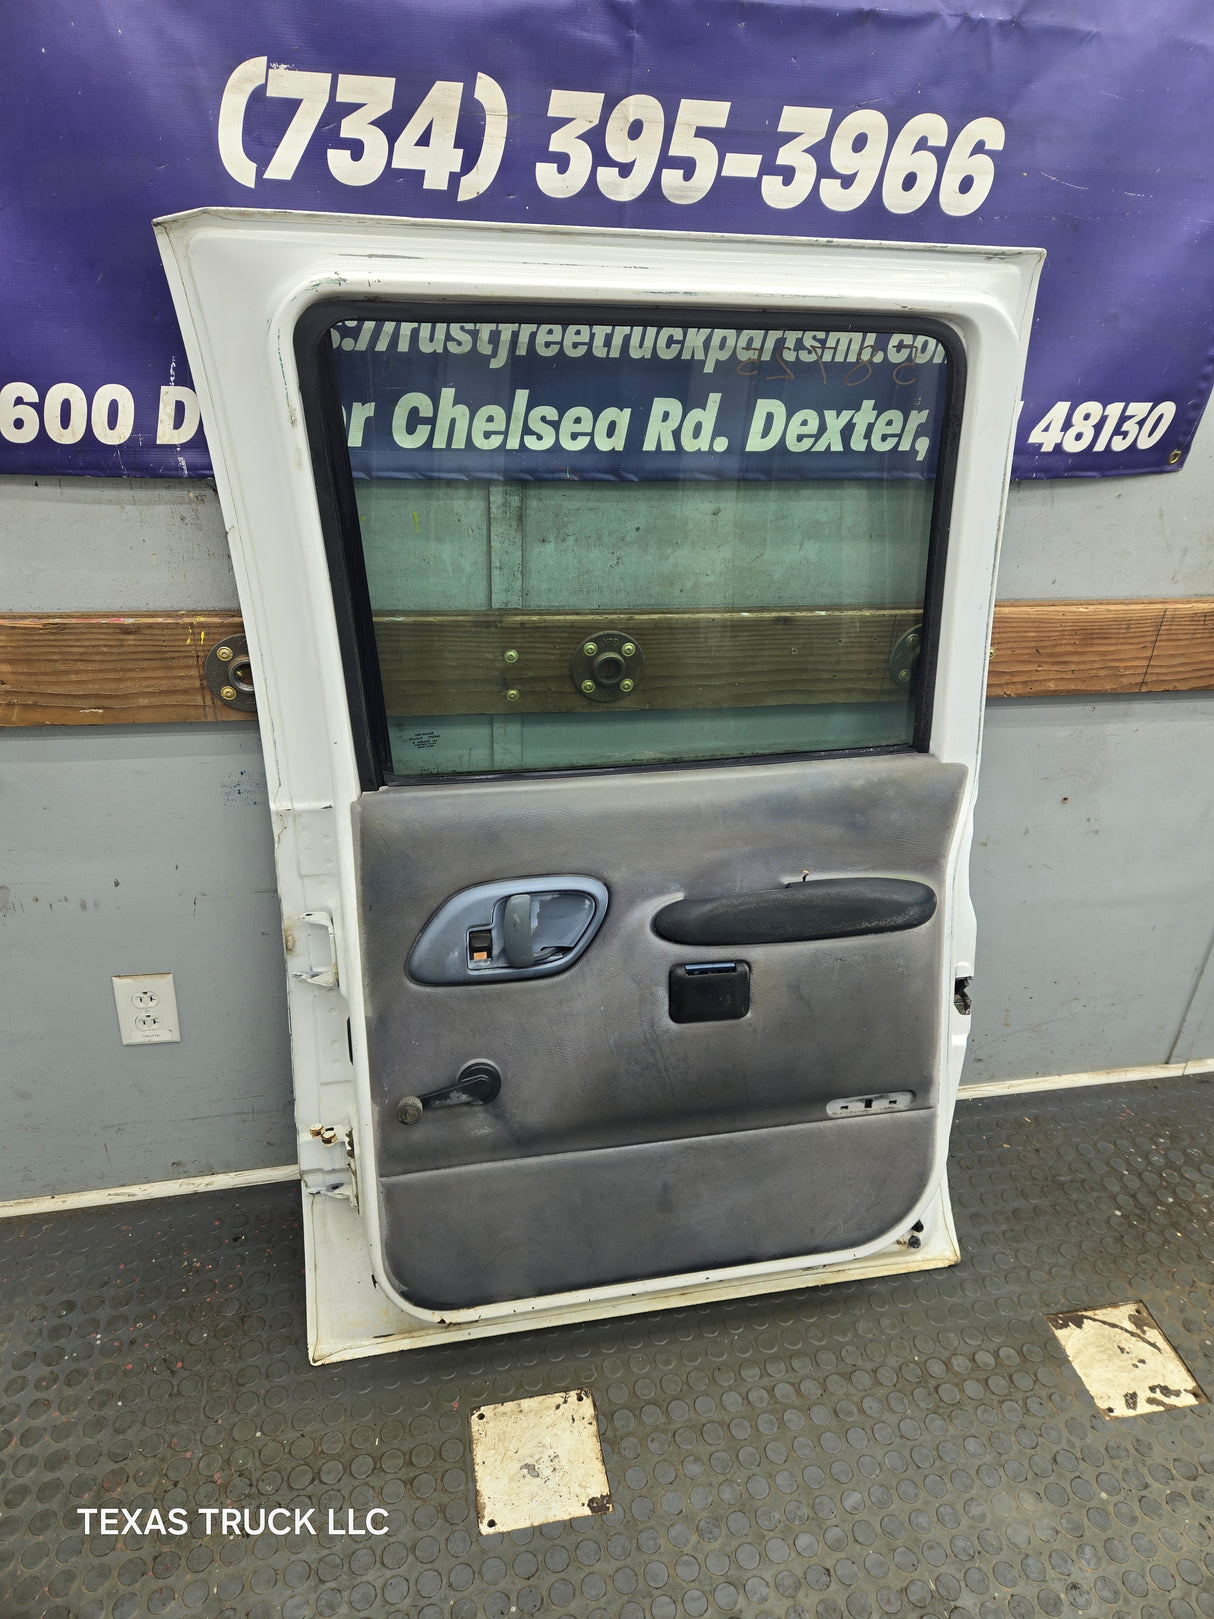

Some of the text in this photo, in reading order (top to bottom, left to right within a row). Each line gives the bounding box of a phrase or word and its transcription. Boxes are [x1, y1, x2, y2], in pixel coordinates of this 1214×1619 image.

[217, 56, 1006, 217] (734) 395-3966
[0, 381, 135, 445] 600
[392, 387, 632, 452] Chelsea
[643, 393, 729, 453] Rd.
[745, 398, 930, 462] Dexter,
[1027, 401, 1177, 453] 48130
